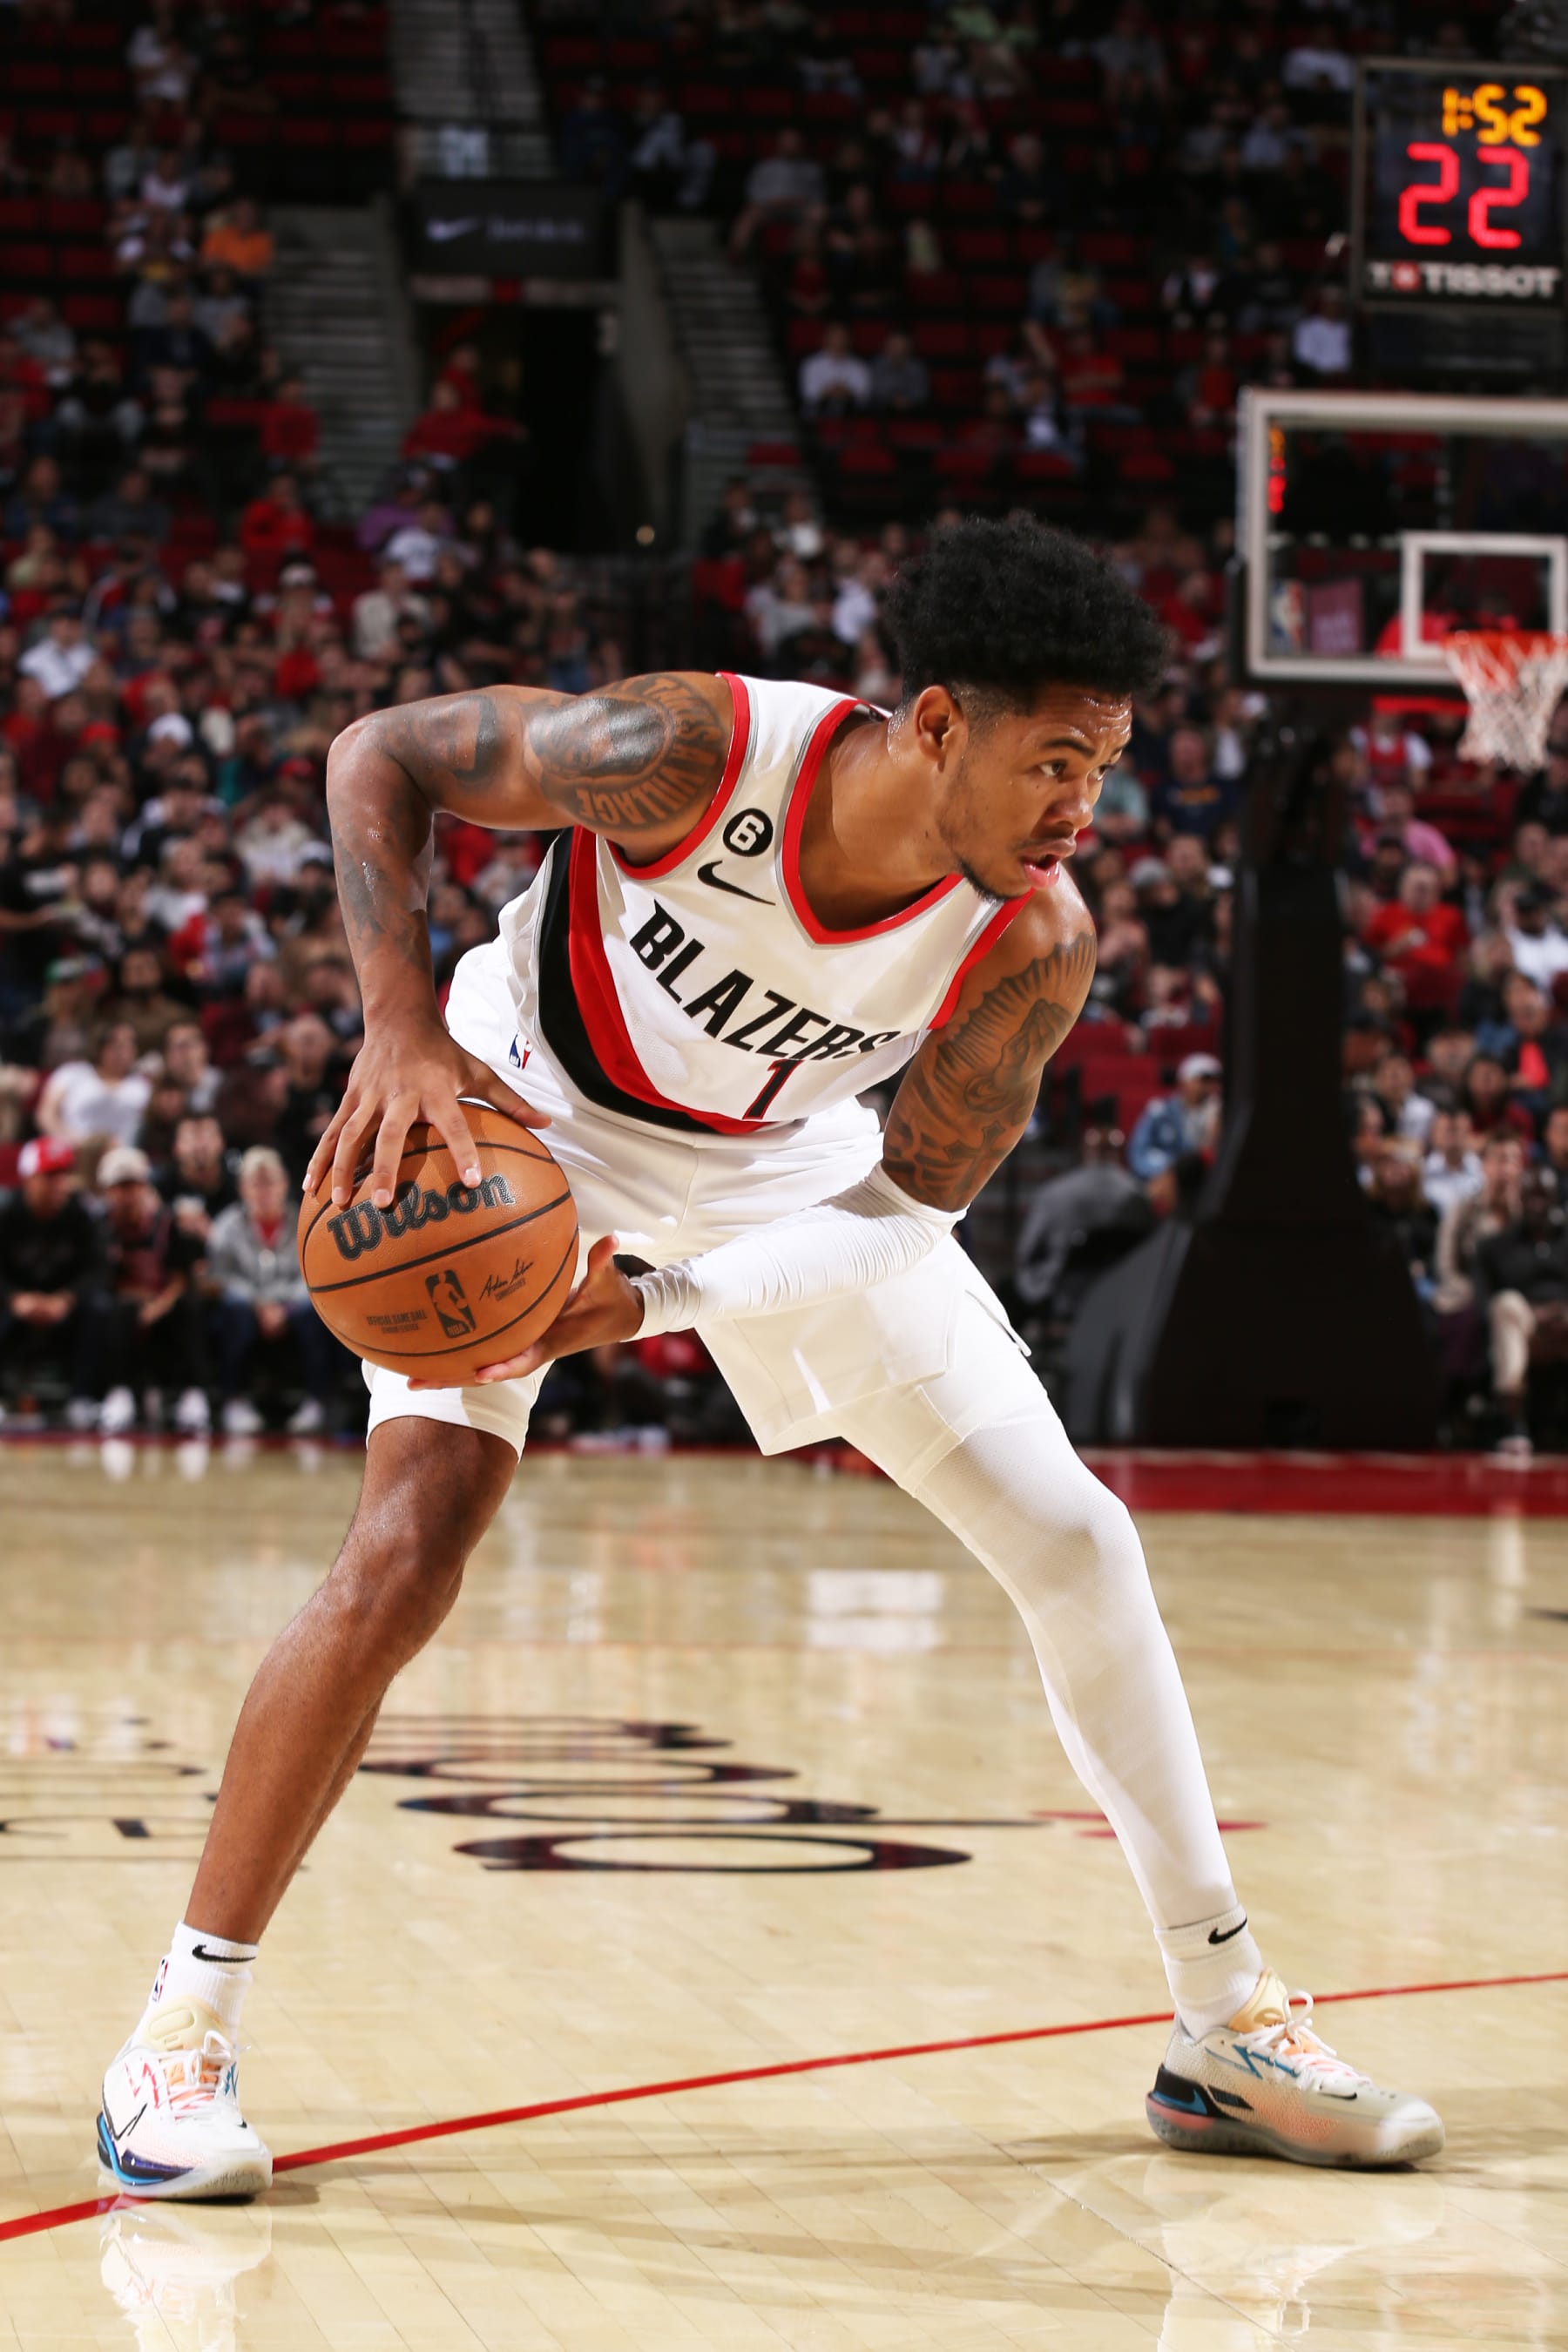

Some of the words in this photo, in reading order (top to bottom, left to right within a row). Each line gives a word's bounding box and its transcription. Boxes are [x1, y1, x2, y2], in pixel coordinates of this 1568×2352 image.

[1442, 83, 1548, 148] 1:52
[1398, 141, 1530, 250] 22
[1424, 262, 1560, 298] TISSOT
[575, 765, 706, 825] VILLAGE
[728, 813, 766, 853] 6
[741, 1058, 805, 1121] 1
[326, 1173, 517, 1262] Wilson
[447, 1323, 468, 1336] NBA
